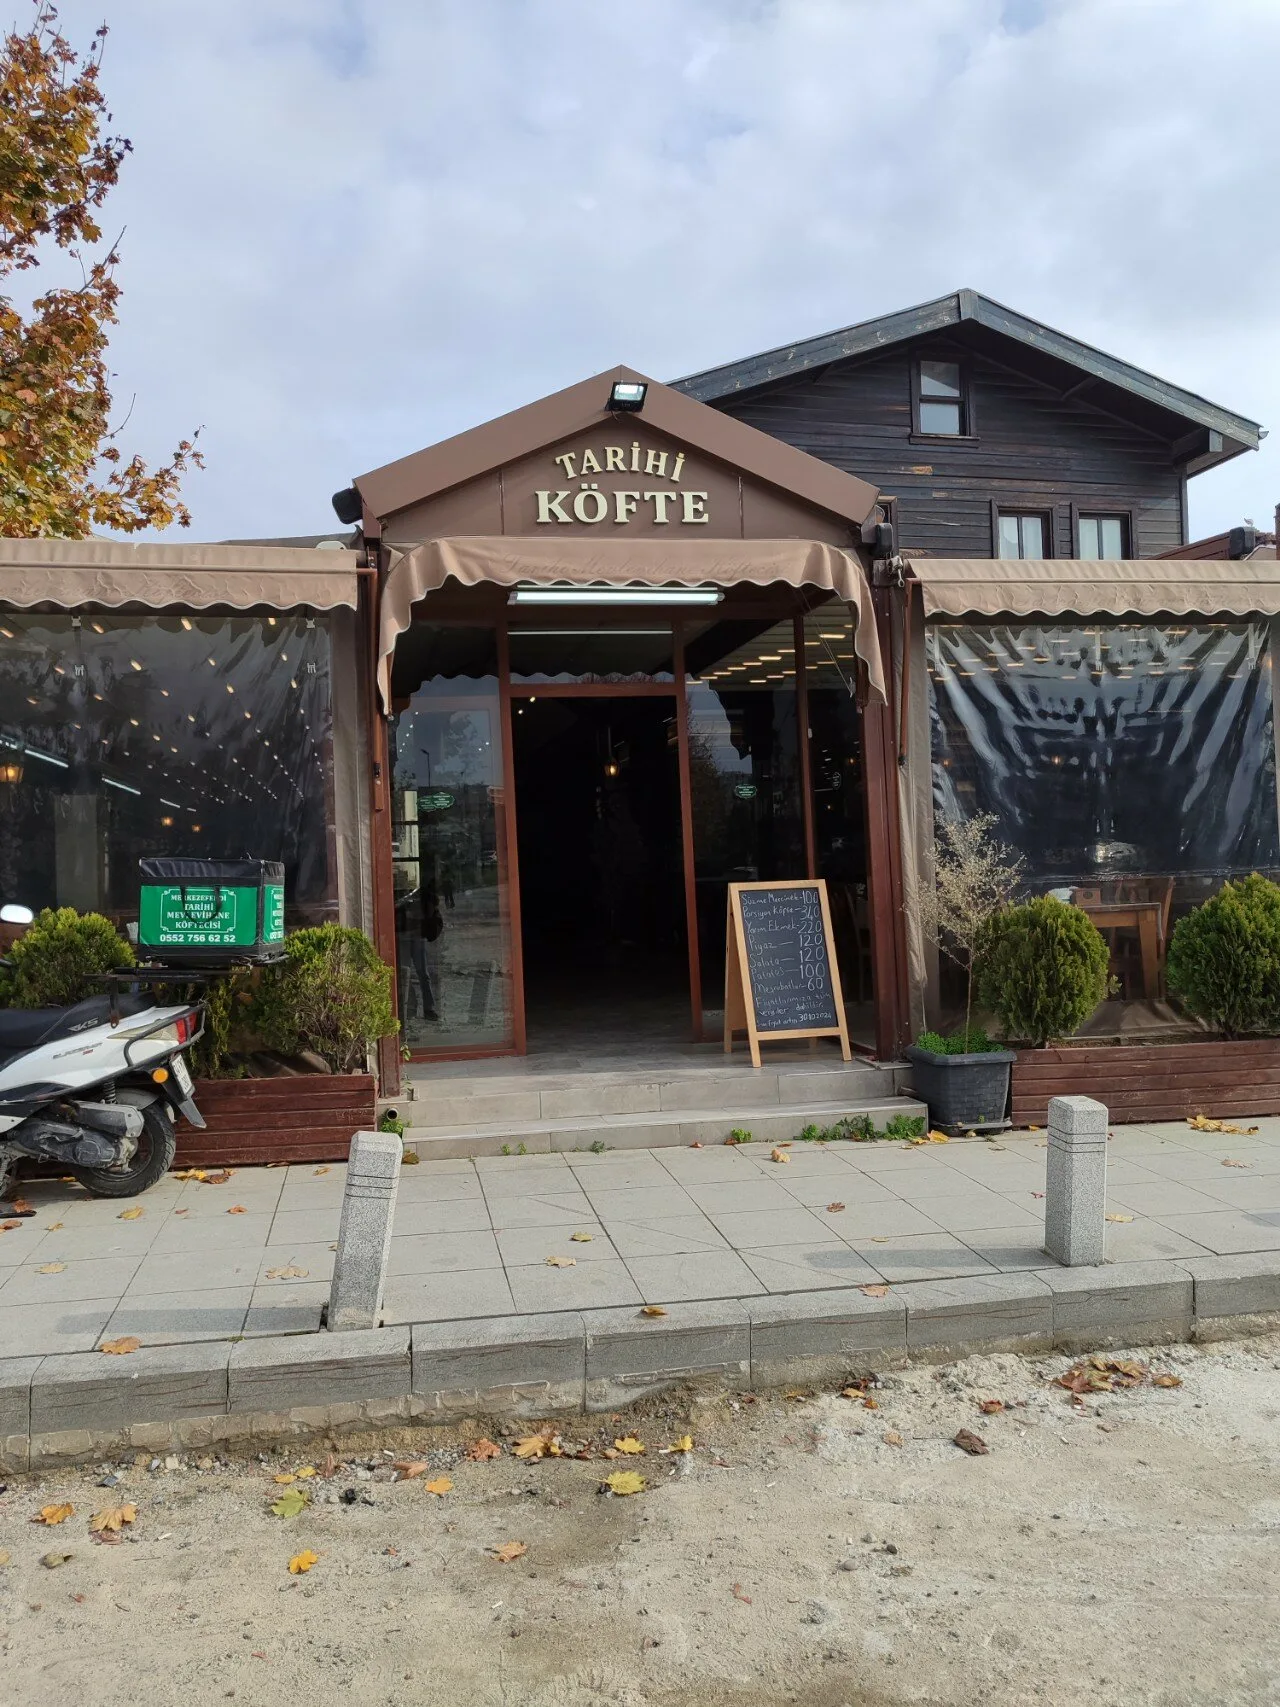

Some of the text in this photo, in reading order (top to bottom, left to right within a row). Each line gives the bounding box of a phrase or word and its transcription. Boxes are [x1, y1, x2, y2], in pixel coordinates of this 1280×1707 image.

[555, 441, 685, 483] TARİHİ
[535, 483, 709, 524] KÖFTE
[185, 902, 214, 911] TARİHİ
[160, 934, 236, 943] 0552 756 62 52
[748, 933, 823, 955] Piyaz 120
[799, 946, 825, 963] 120
[800, 962, 826, 979] 100
[807, 977, 824, 991] 60
